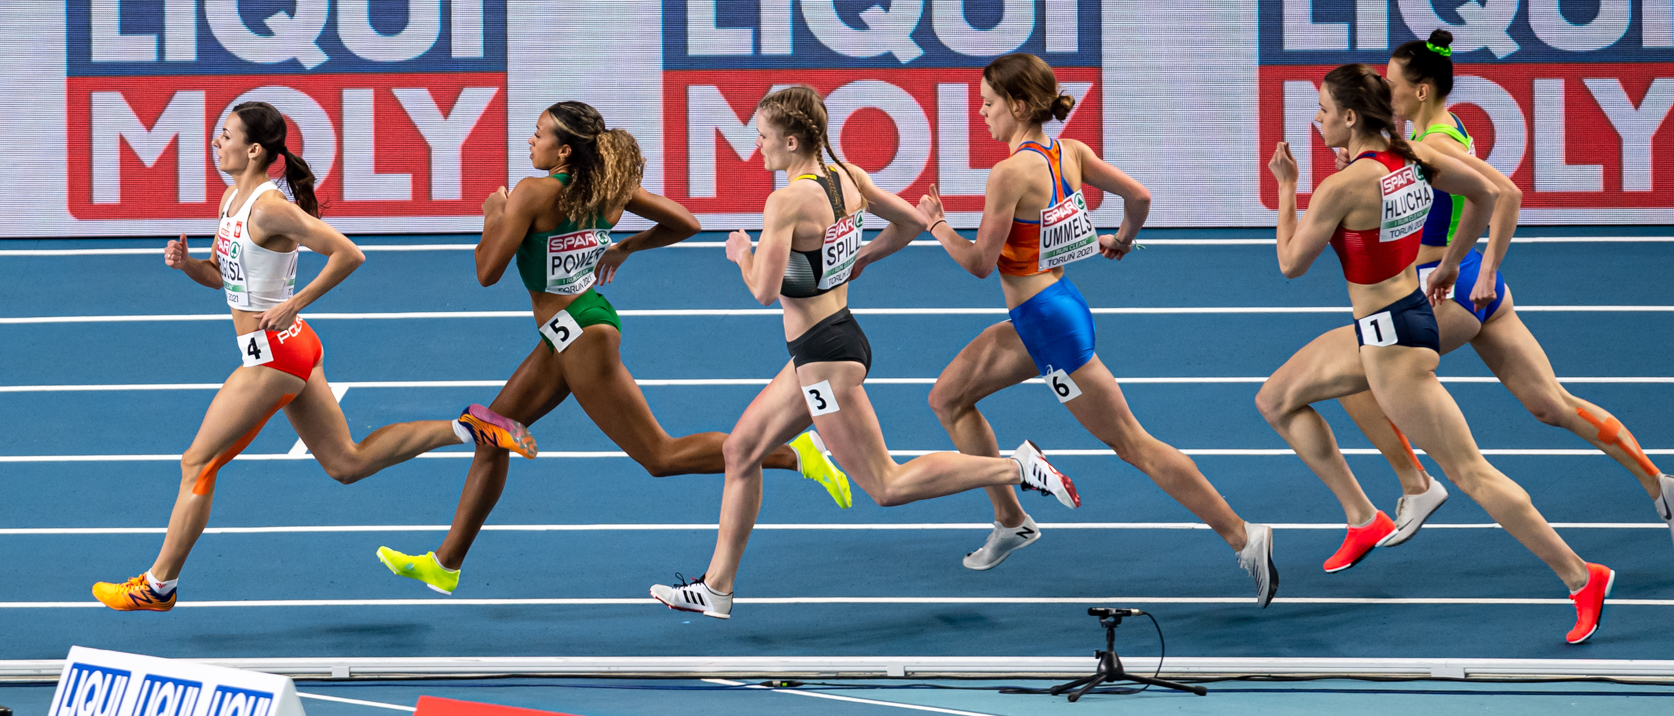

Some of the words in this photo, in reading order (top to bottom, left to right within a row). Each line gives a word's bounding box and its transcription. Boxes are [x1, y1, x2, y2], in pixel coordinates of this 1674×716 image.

[91, 0, 484, 70] LIQUI
[1383, 170, 1415, 193] SPAR
[1385, 182, 1431, 219] HLUCHÁ
[1043, 200, 1079, 226] SPAR
[551, 232, 597, 251] SPAR
[1043, 212, 1092, 248] UMMELS
[552, 247, 605, 275] POWER
[827, 232, 861, 266] SPILL
[1077, 246, 1093, 258] 2021
[549, 318, 570, 342] 5
[1370, 319, 1383, 343] 1
[247, 336, 262, 360] 4
[1052, 376, 1070, 397] 6
[808, 389, 827, 410] 3
[57, 668, 128, 716] LIQUI
